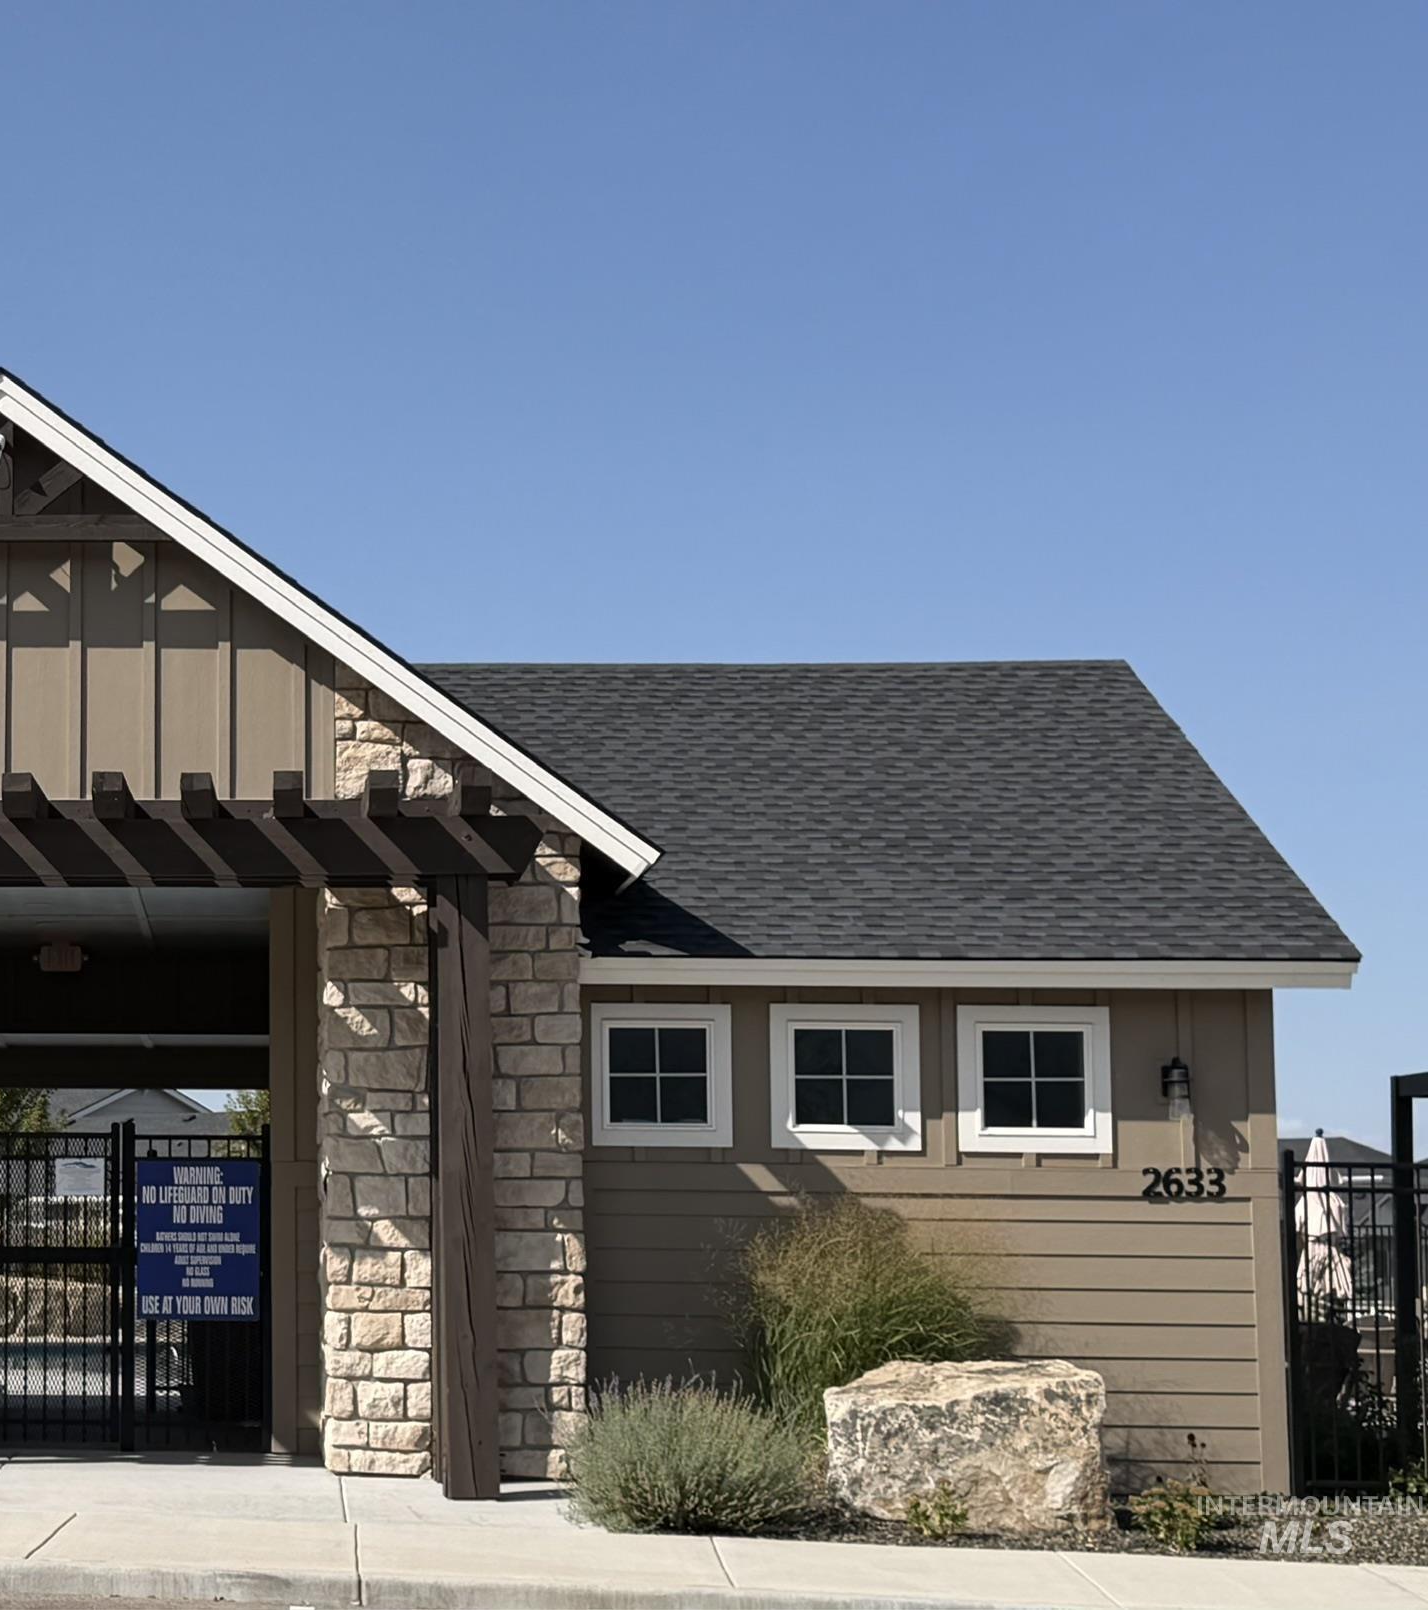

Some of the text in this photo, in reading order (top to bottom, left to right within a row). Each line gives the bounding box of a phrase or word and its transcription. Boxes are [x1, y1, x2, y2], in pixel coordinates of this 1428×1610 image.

[173, 1166, 223, 1185] WARNING:
[1142, 1167, 1226, 1198] 2633
[142, 1186, 253, 1204] NO LIFEGUARD ON DUTY
[173, 1205, 223, 1224] NO DIVING
[140, 1243, 164, 1253] CHILDREN
[173, 1243, 188, 1253] YEARS
[142, 1296, 254, 1315] USE AT YOUR OWN RISK
